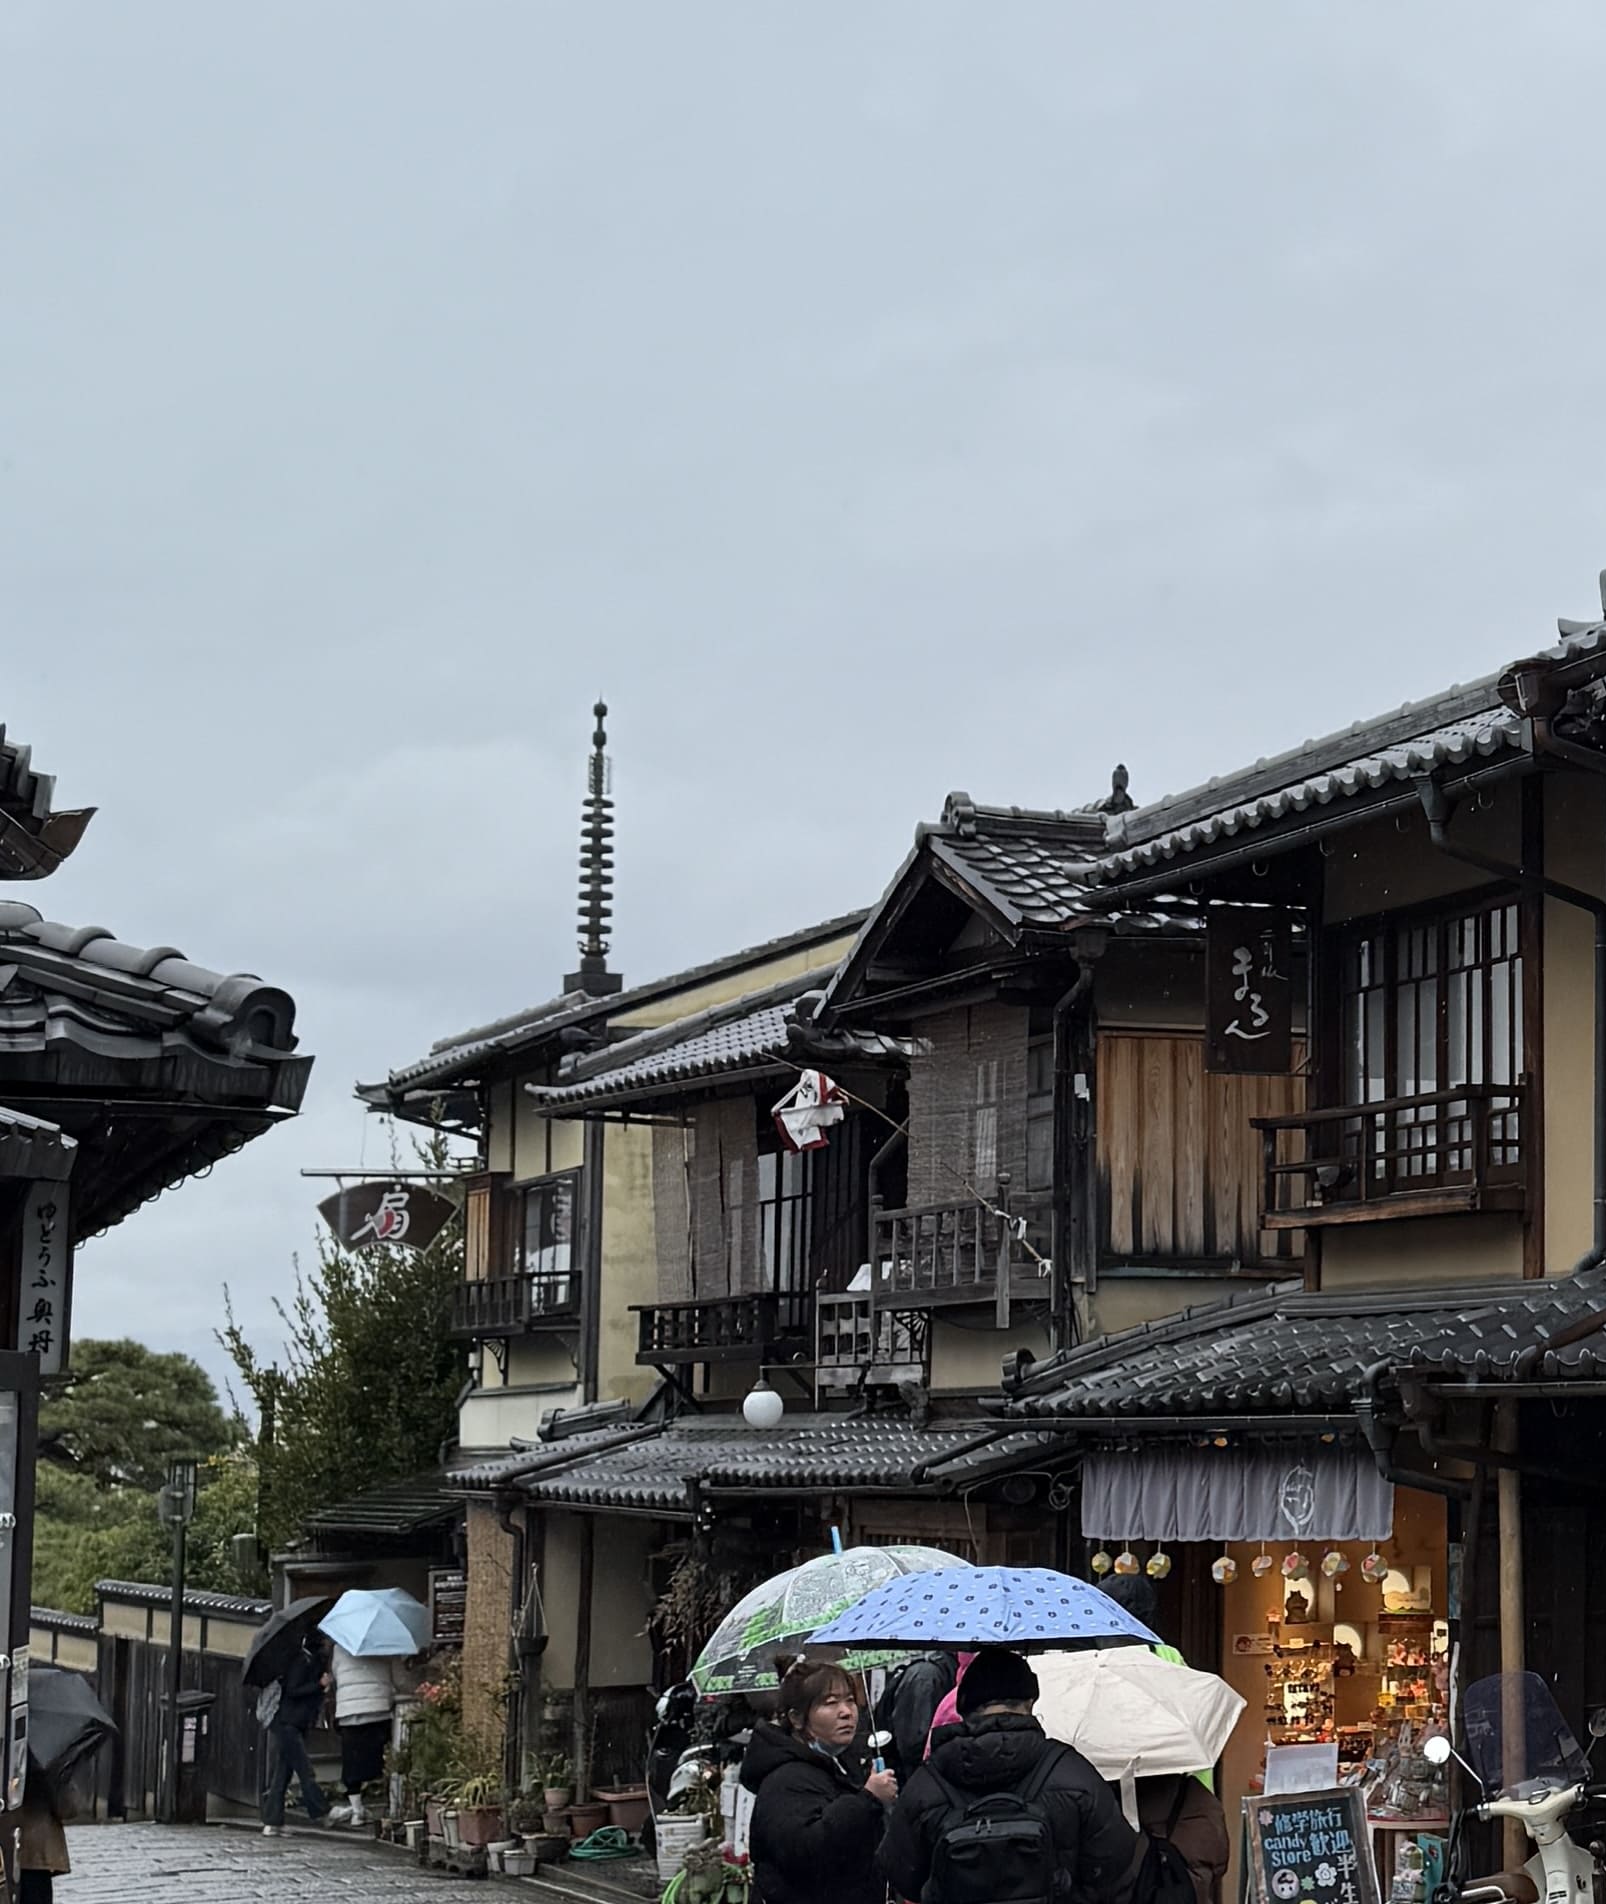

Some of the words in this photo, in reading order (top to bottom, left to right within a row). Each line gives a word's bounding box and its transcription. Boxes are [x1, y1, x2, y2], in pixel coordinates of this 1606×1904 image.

[1274, 1806, 1343, 1836] 修学旅行
[1263, 1832, 1307, 1851] candy
